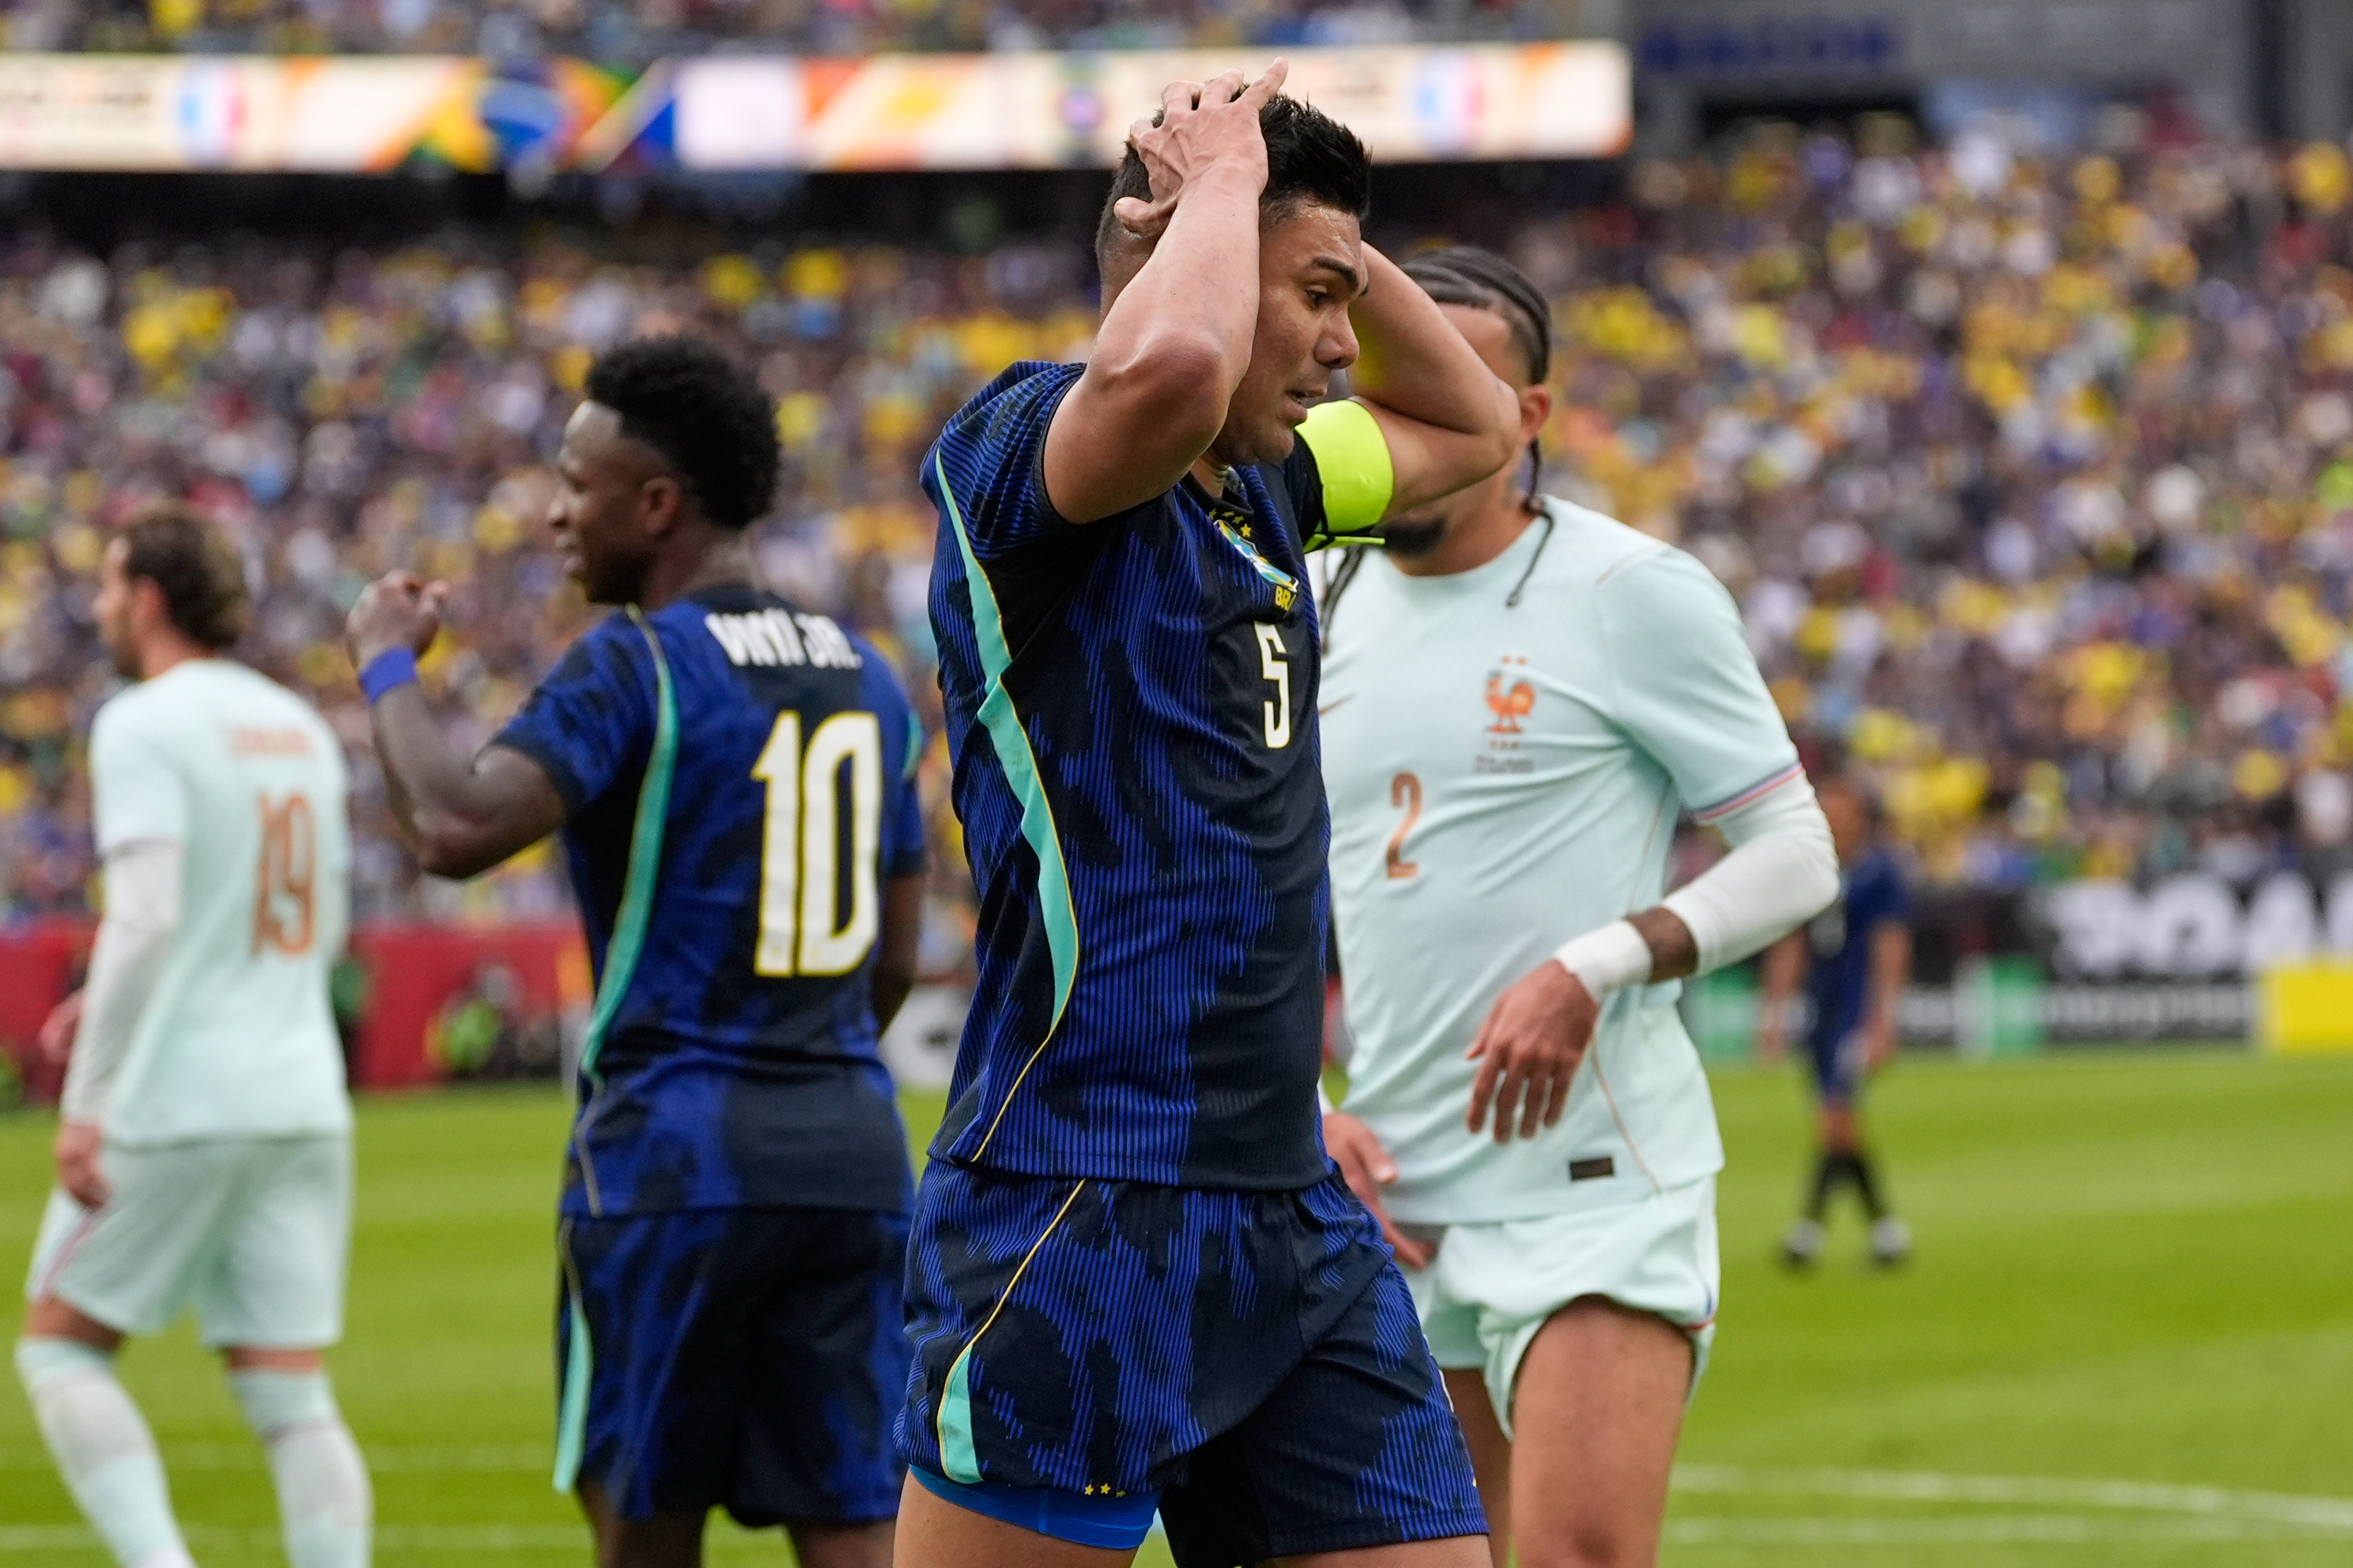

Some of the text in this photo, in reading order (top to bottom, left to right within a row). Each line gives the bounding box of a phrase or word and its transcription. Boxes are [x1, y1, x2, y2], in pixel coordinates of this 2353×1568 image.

[1254, 620, 1291, 749] 5
[252, 791, 316, 962] 19
[751, 709, 883, 978] 10
[1386, 771, 1423, 879] 2
